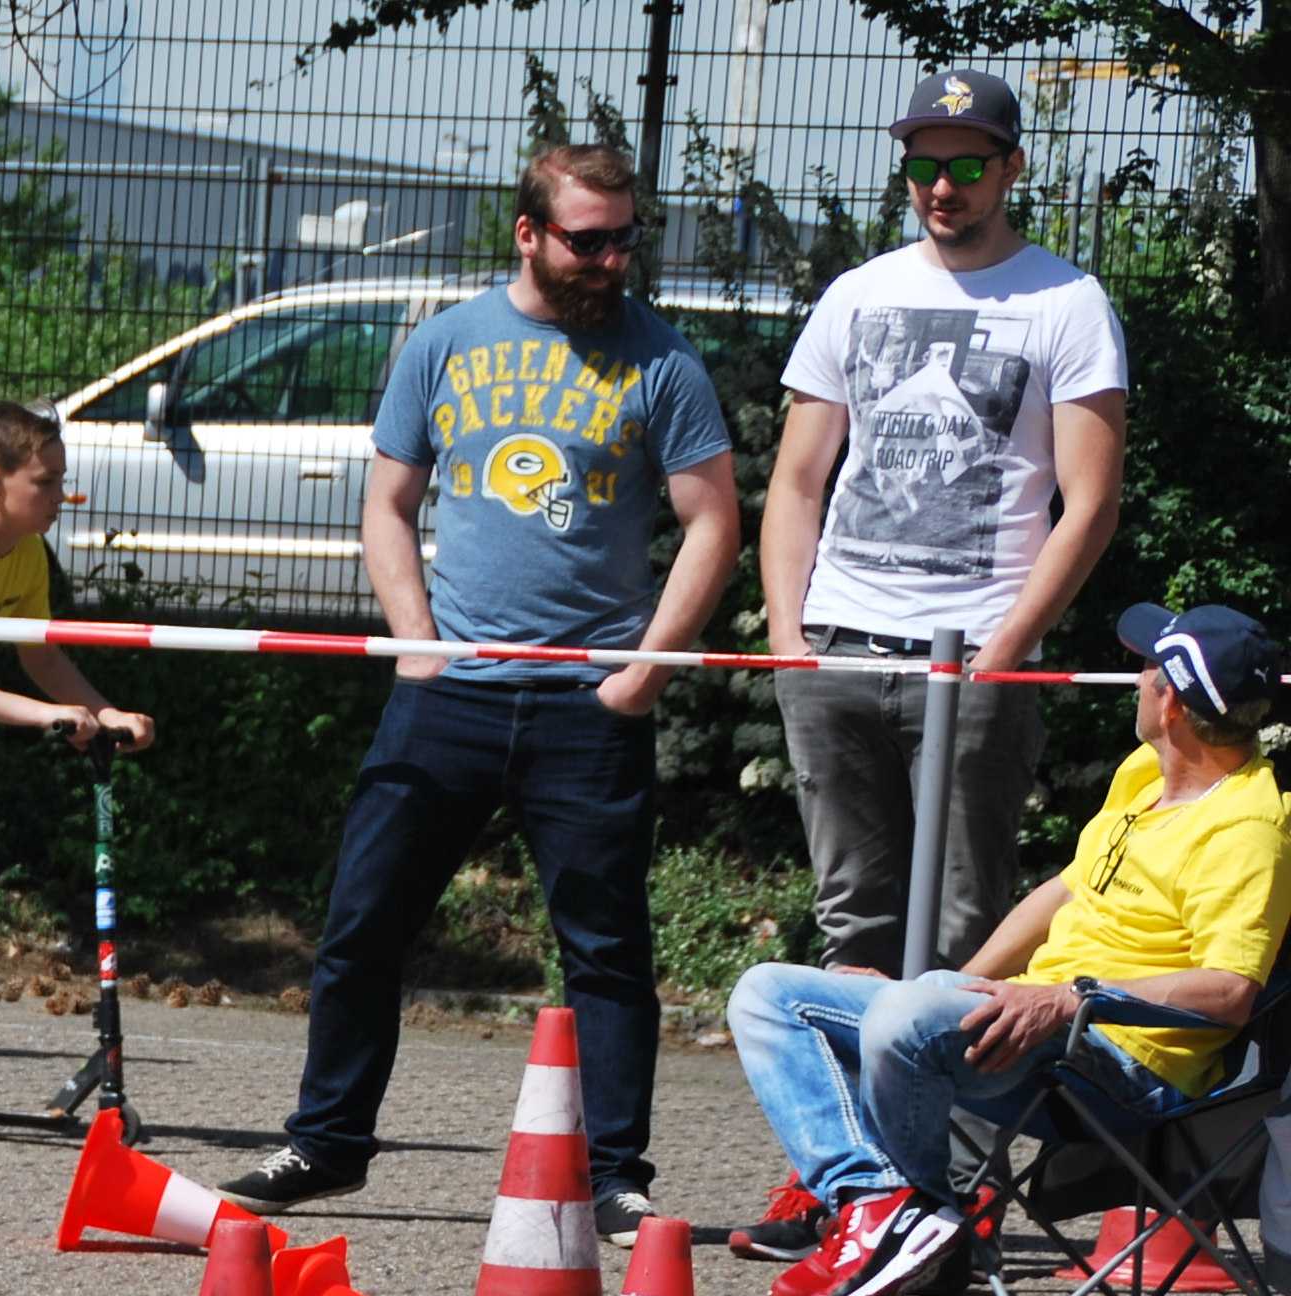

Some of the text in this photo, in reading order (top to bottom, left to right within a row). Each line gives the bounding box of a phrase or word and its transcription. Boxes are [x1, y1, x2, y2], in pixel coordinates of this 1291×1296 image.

[447, 339, 642, 405] GREEN BAY
[434, 384, 644, 457] PACKERS
[937, 415, 972, 437] DAY
[876, 447, 955, 471] ROAD TRIP
